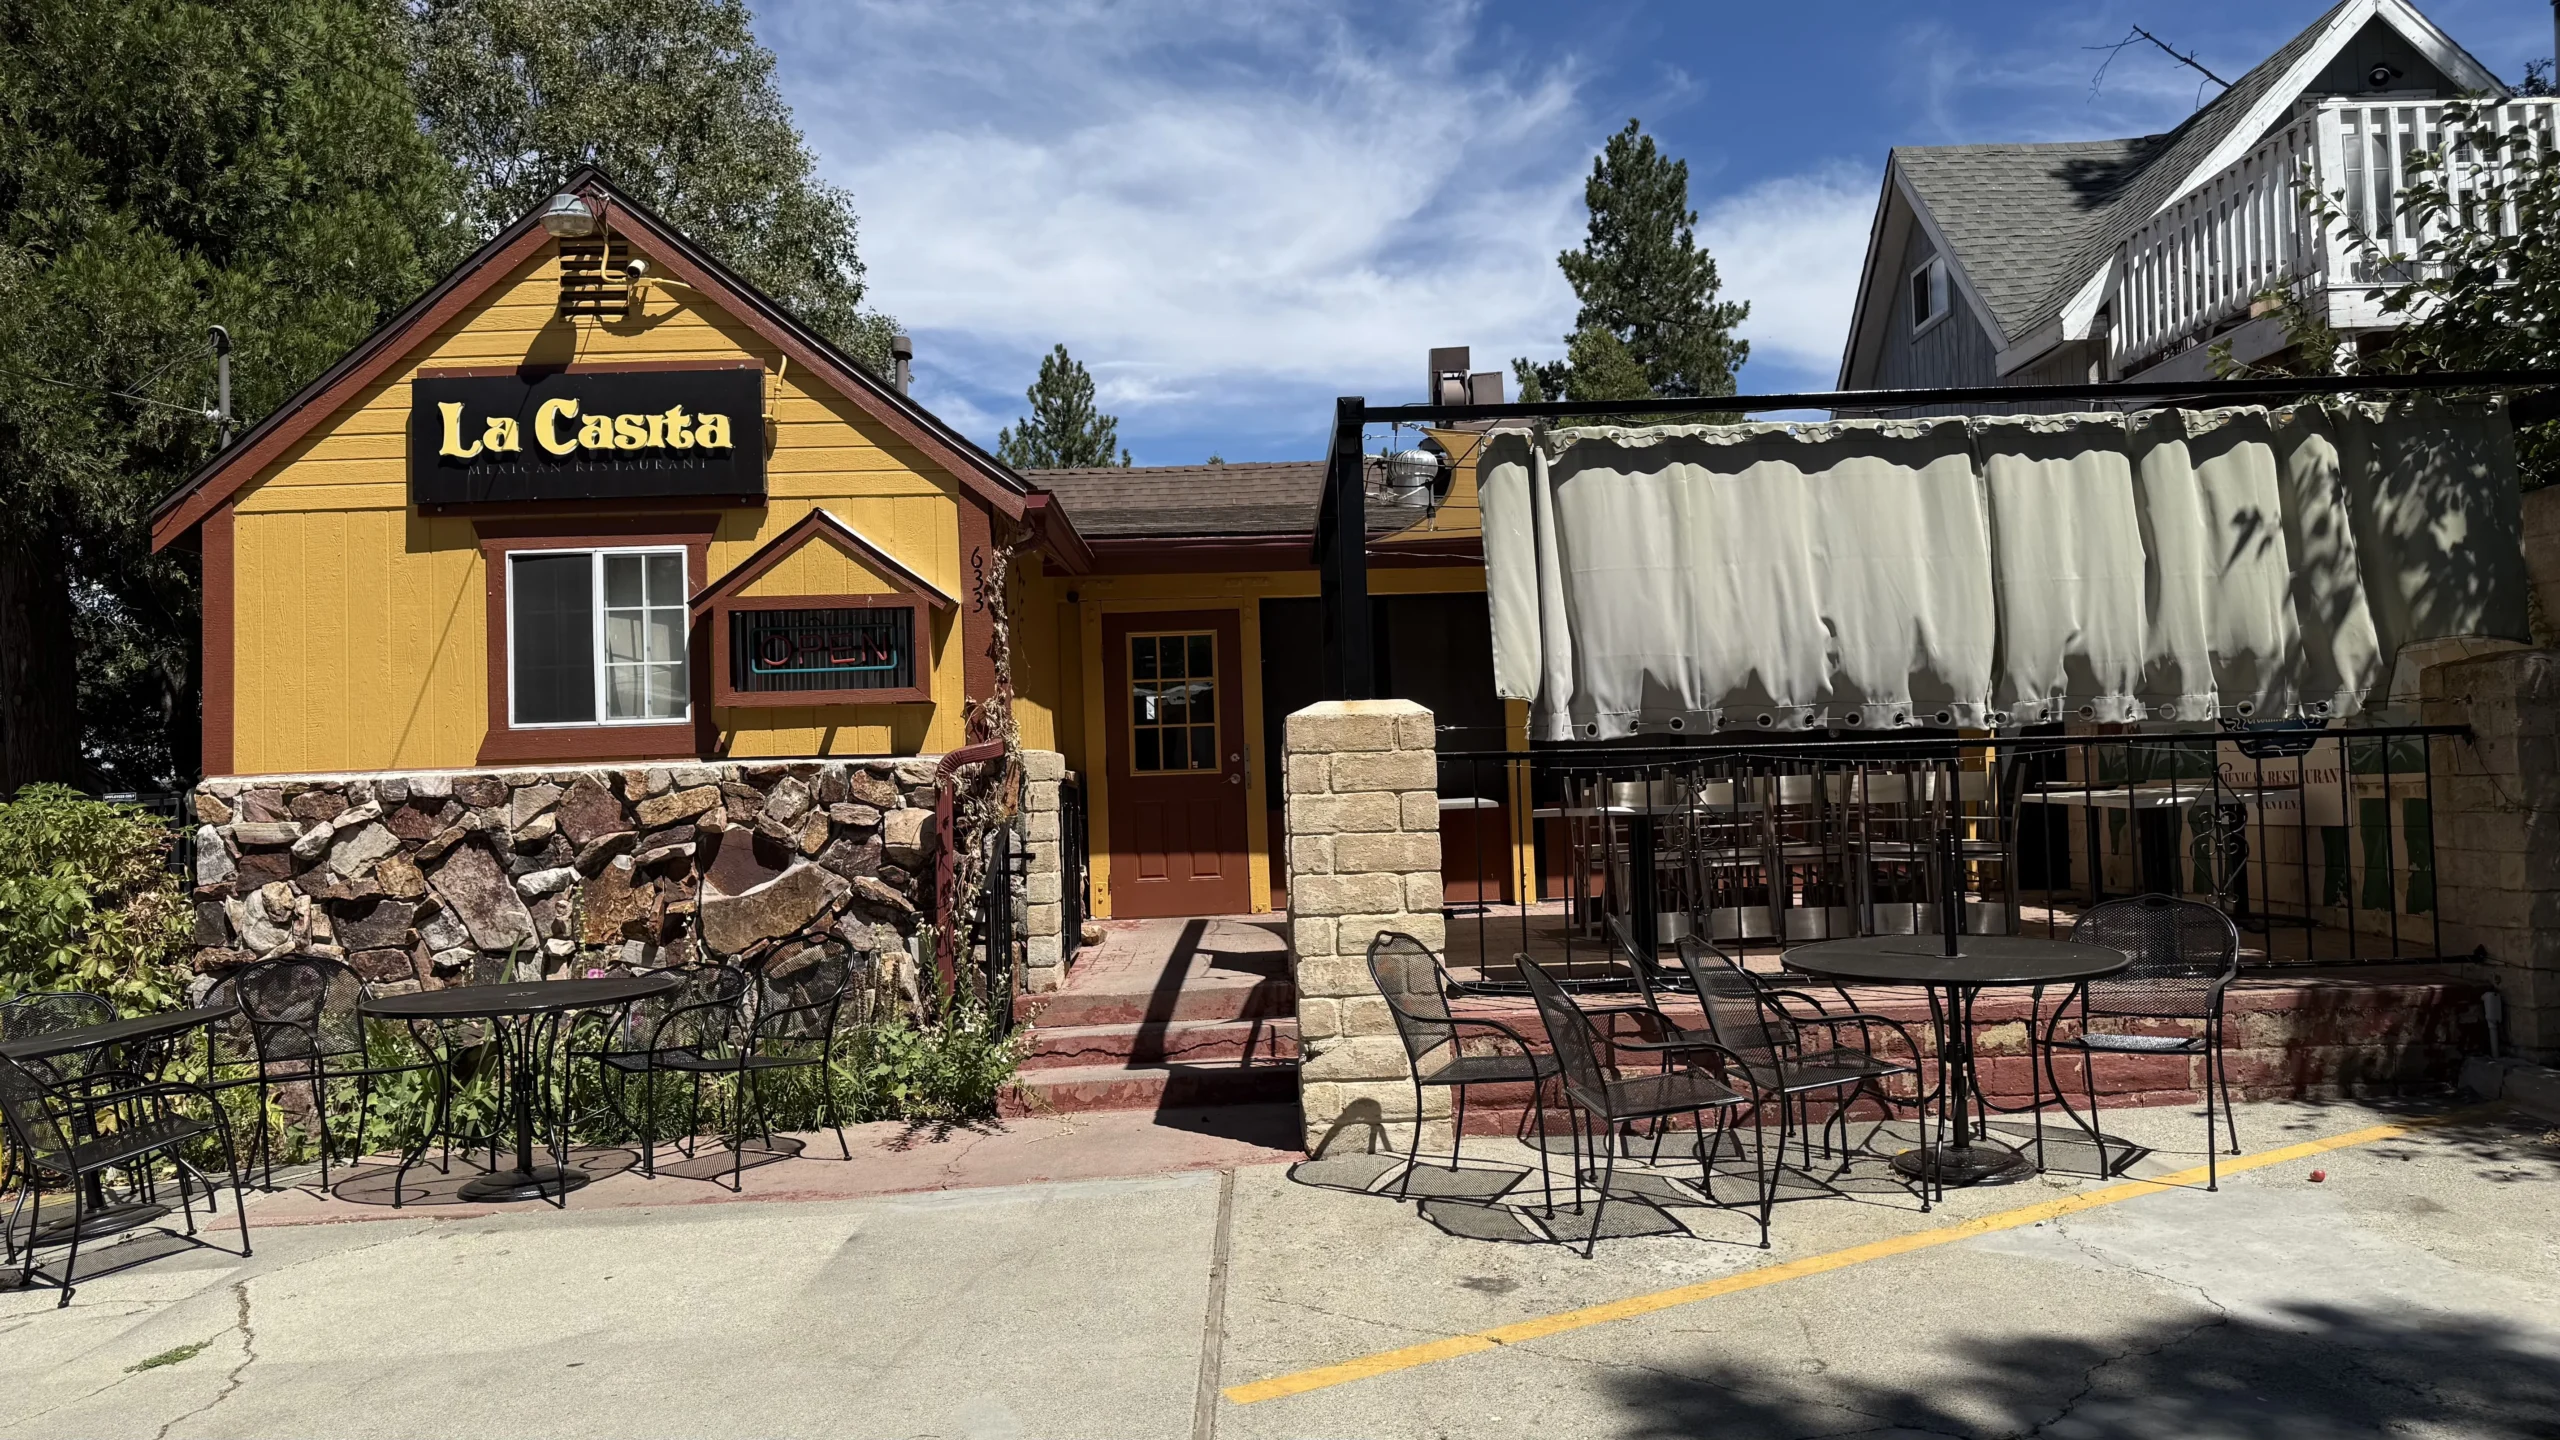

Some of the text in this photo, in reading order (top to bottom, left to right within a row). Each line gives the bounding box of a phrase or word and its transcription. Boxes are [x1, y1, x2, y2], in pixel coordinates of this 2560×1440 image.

[438, 398, 735, 458] La Casita
[468, 459, 707, 475] MEXICAN RESTAURANT
[970, 546, 984, 613] 633
[761, 632, 888, 665] OPEN
[2268, 768, 2342, 784] RESTURAN
[2256, 800, 2302, 810] ANTIN
